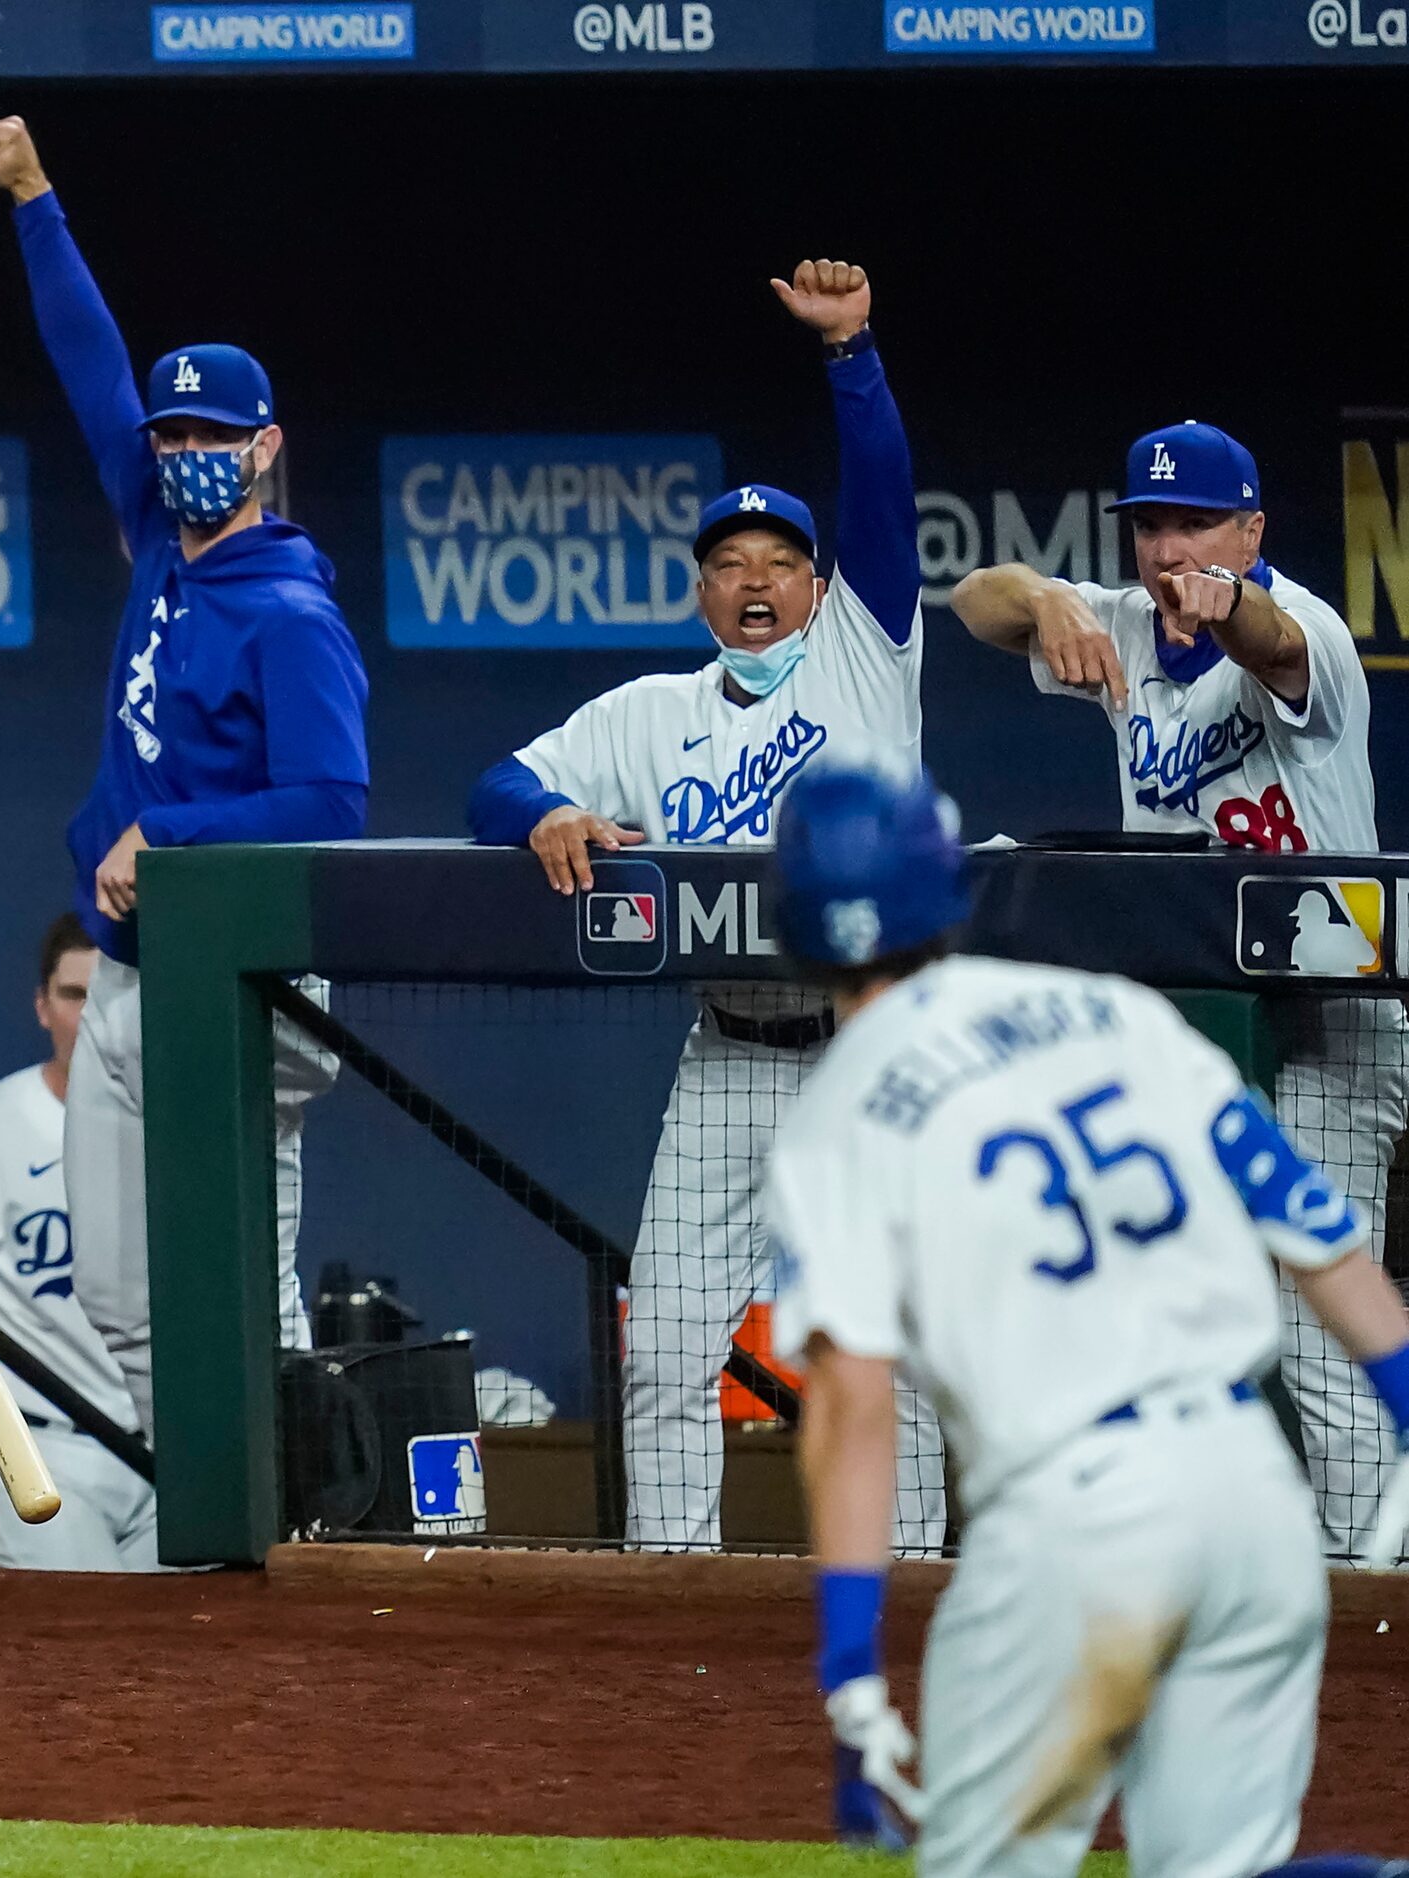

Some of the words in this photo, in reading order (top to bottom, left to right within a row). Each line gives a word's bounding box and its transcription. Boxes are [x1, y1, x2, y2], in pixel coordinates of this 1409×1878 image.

[161, 15, 294, 49] CAMPING
[295, 14, 405, 48] WORLD
[573, 3, 715, 51] @MLB
[894, 7, 1031, 42] CAMPING
[1032, 6, 1146, 41] WORLD
[172, 355, 202, 393] LA
[1148, 442, 1177, 481] LA
[400, 461, 700, 536] CAMPING
[738, 485, 768, 513] LA
[406, 538, 698, 627] WORLD
[976, 1083, 1188, 1281] 35
